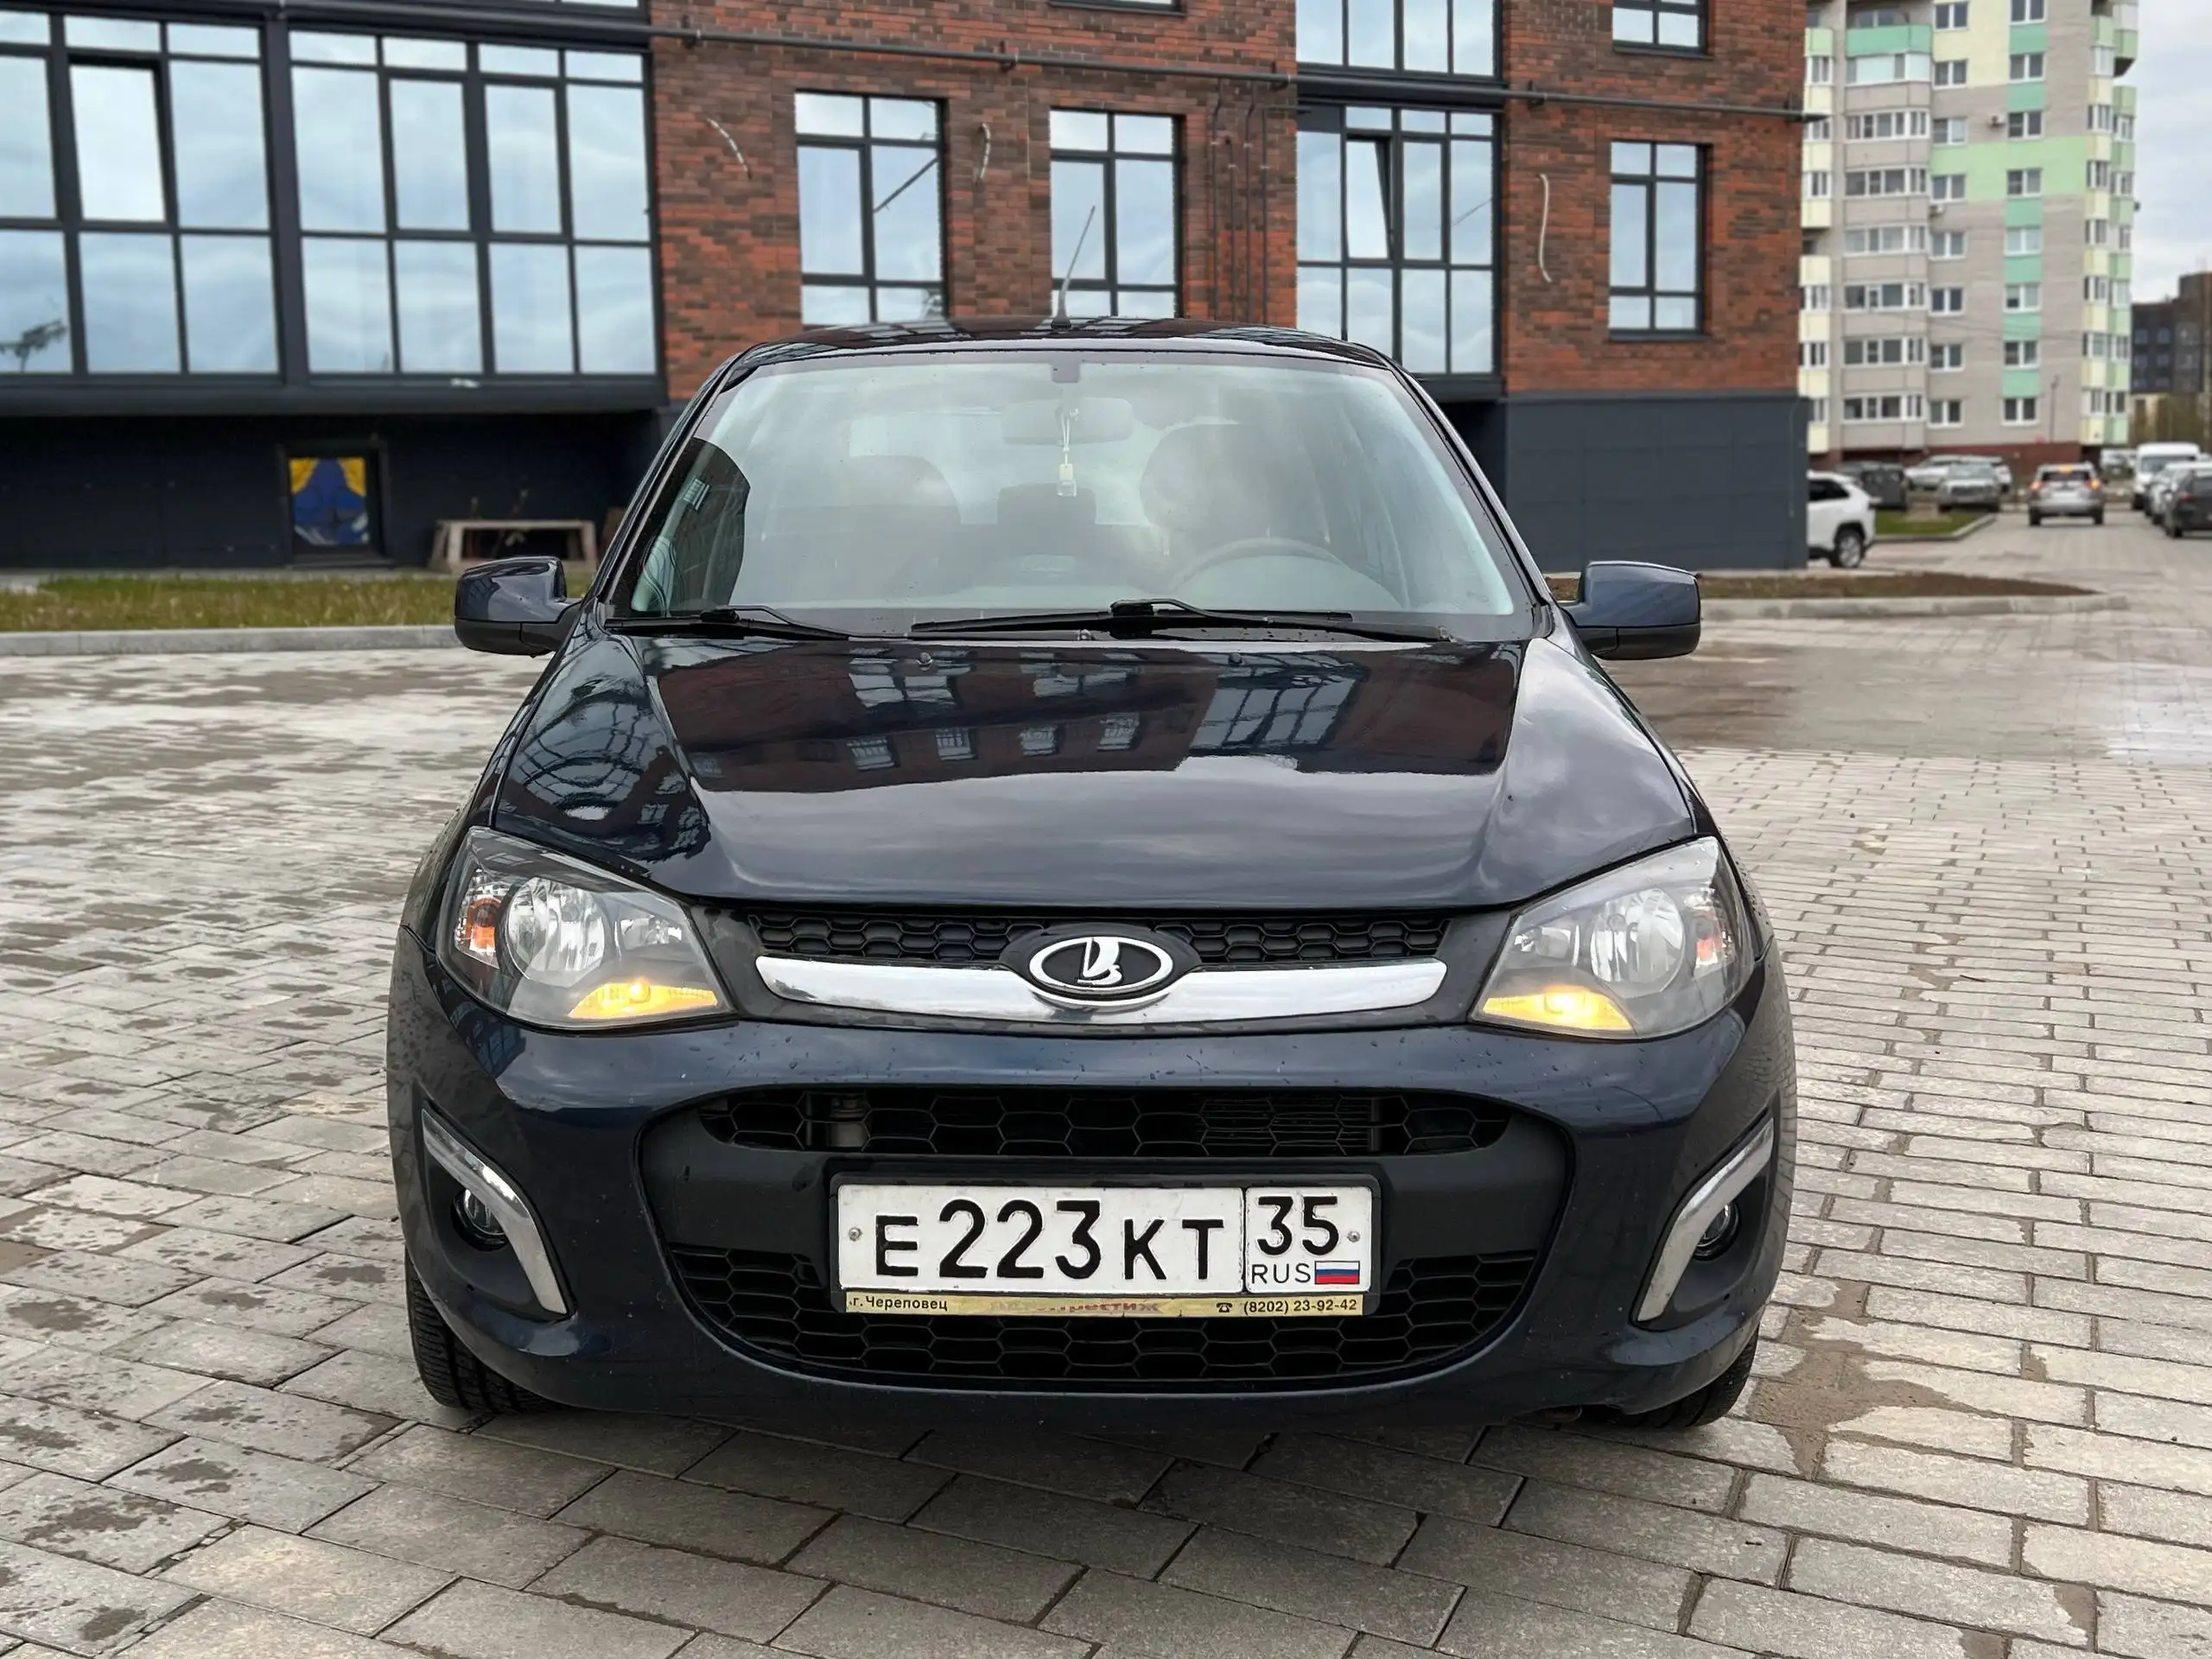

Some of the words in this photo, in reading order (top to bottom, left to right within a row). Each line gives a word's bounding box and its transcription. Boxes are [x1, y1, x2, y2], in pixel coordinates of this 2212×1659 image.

[1256, 1195, 1339, 1255] 35
[1252, 1262, 1311, 1284] RUS
[1243, 1300, 1289, 1315] (8202)
[1293, 1299, 1357, 1312] 23-92-42
